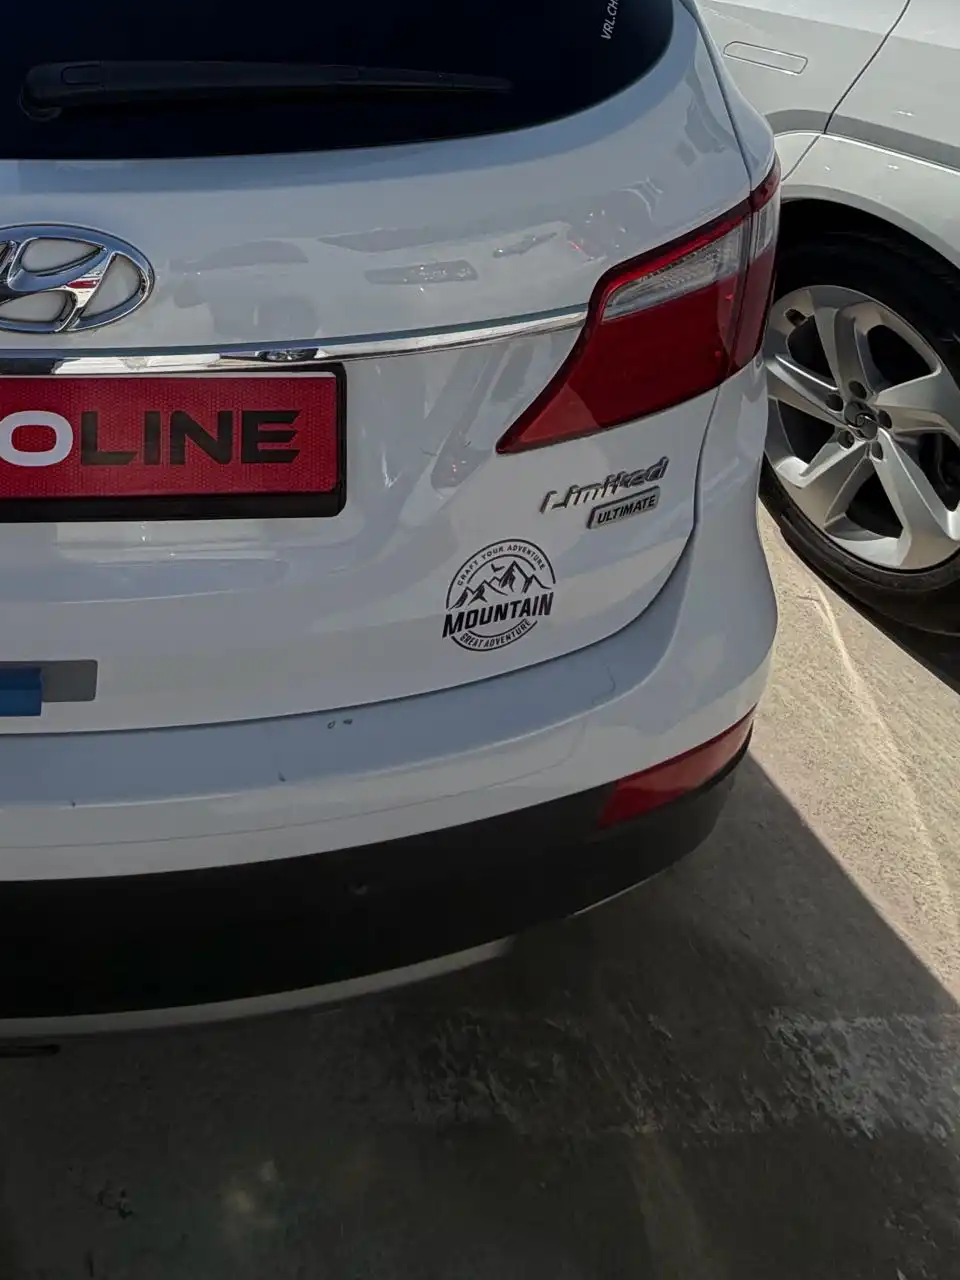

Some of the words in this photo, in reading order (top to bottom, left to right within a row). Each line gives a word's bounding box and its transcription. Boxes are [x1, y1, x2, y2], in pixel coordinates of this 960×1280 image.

[597, 494, 657, 525] ULTIMATE
[457, 559, 479, 586] CRAFT
[482, 547, 505, 560] YOUR
[507, 544, 546, 571] ADVENTURE
[442, 591, 554, 638] MOUNTAIN
[459, 631, 484, 648] GREAT
[483, 619, 532, 648] ADVENTURE
